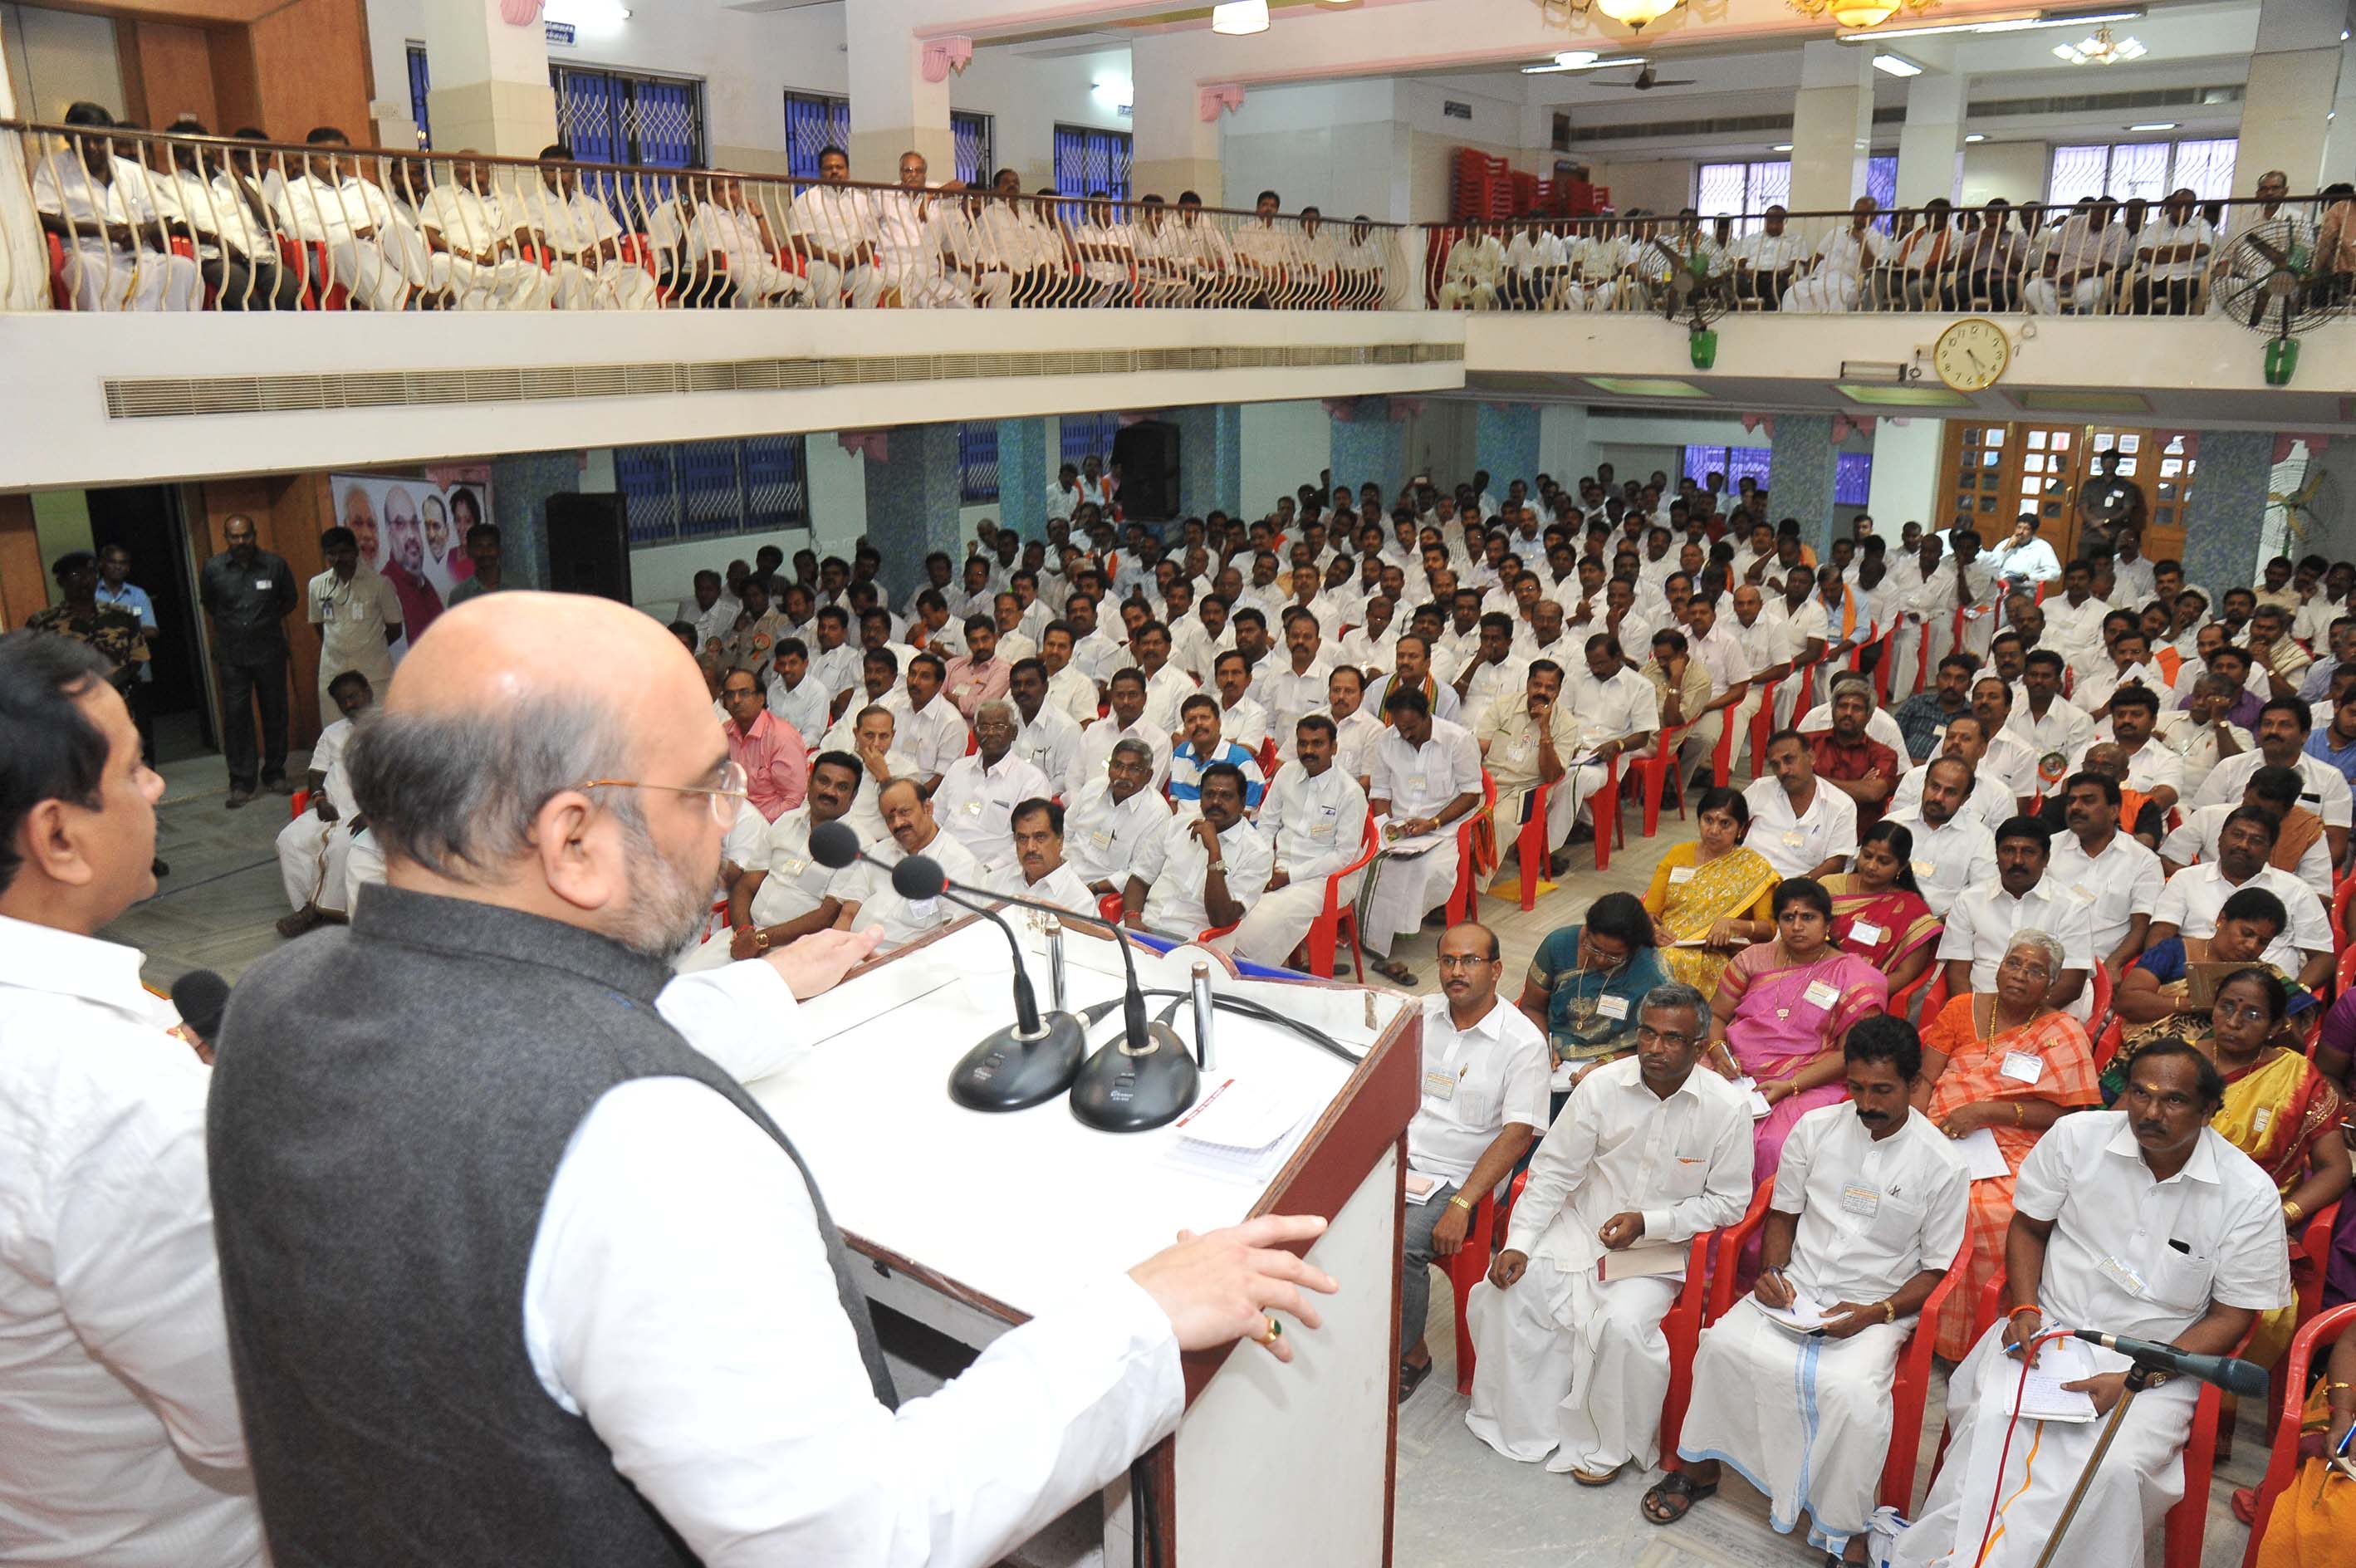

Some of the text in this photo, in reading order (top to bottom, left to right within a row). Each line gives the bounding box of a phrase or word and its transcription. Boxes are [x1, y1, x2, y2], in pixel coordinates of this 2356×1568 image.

[1971, 325, 1978, 334] 12
[1948, 338, 1957, 346] 10
[1996, 351, 2002, 360] 3
[1955, 372, 1962, 382] 7
[1967, 375, 1972, 385] 6
